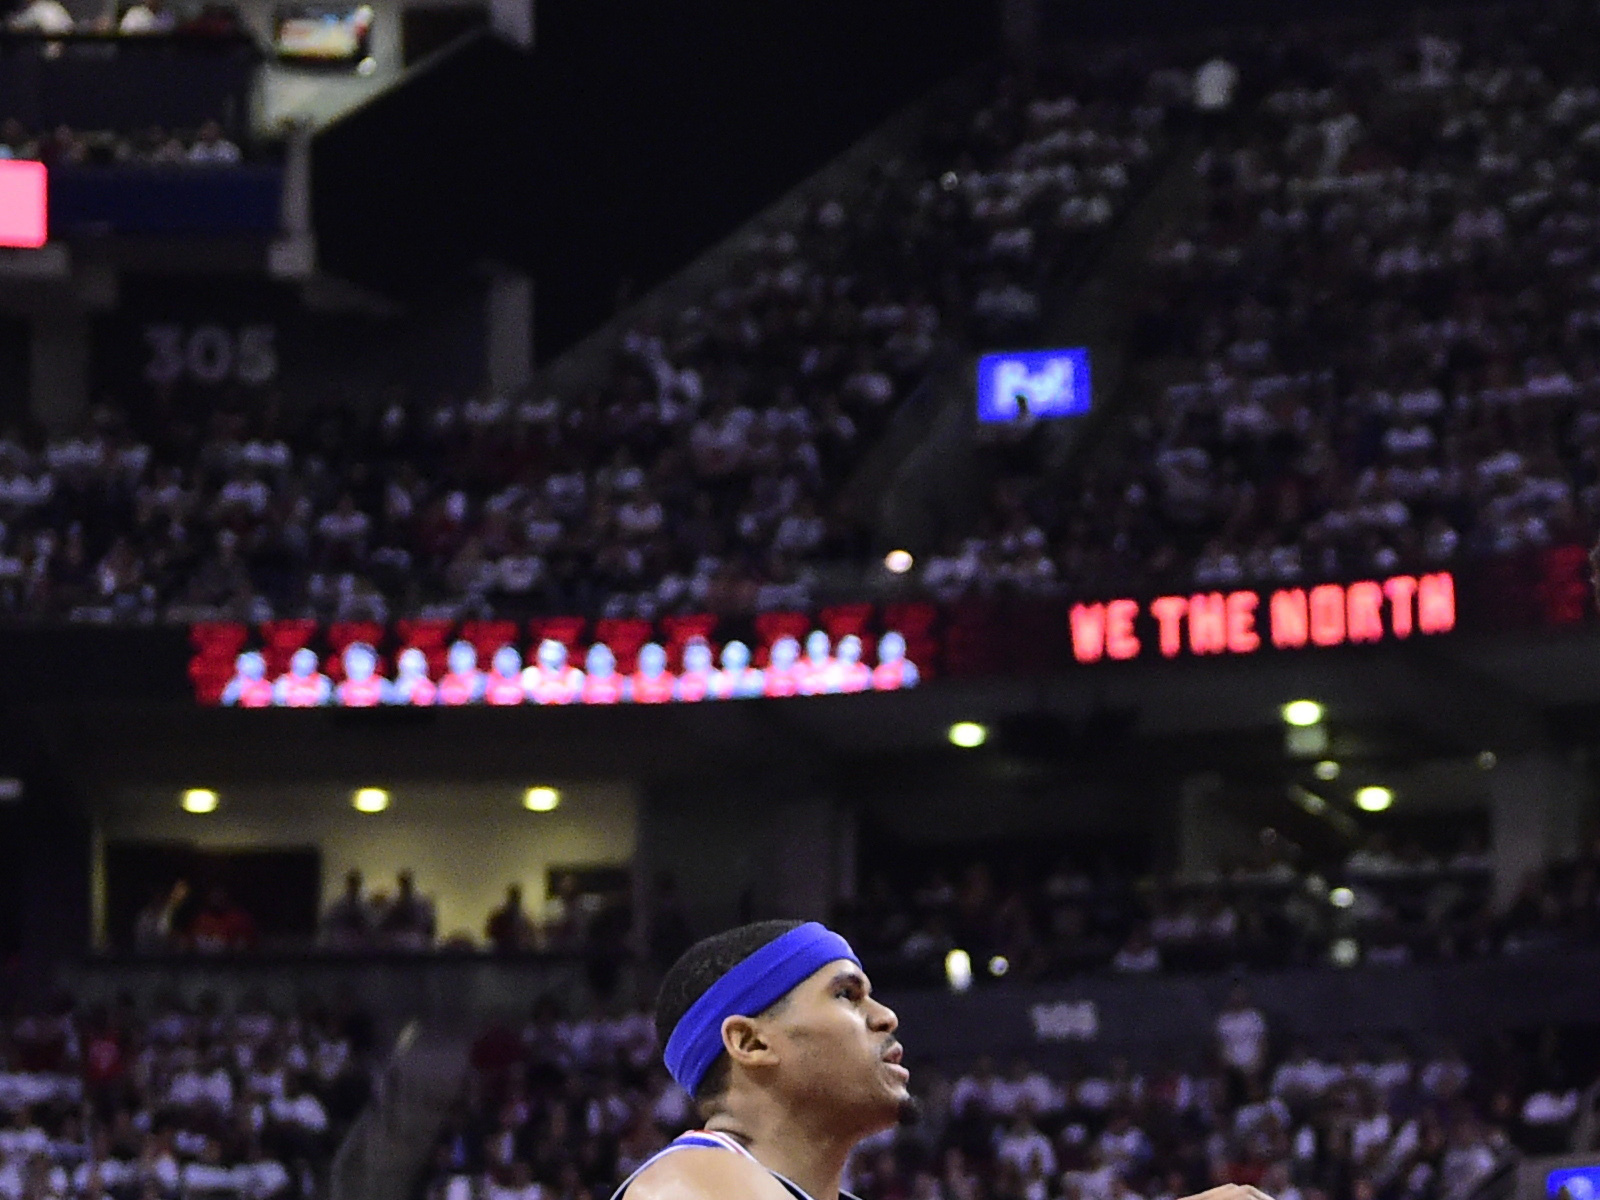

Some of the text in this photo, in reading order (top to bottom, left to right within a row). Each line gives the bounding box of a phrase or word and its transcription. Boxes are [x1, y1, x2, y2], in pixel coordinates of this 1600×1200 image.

[144, 323, 278, 384] 305
[1069, 571, 1456, 664] WE THE NORTH
